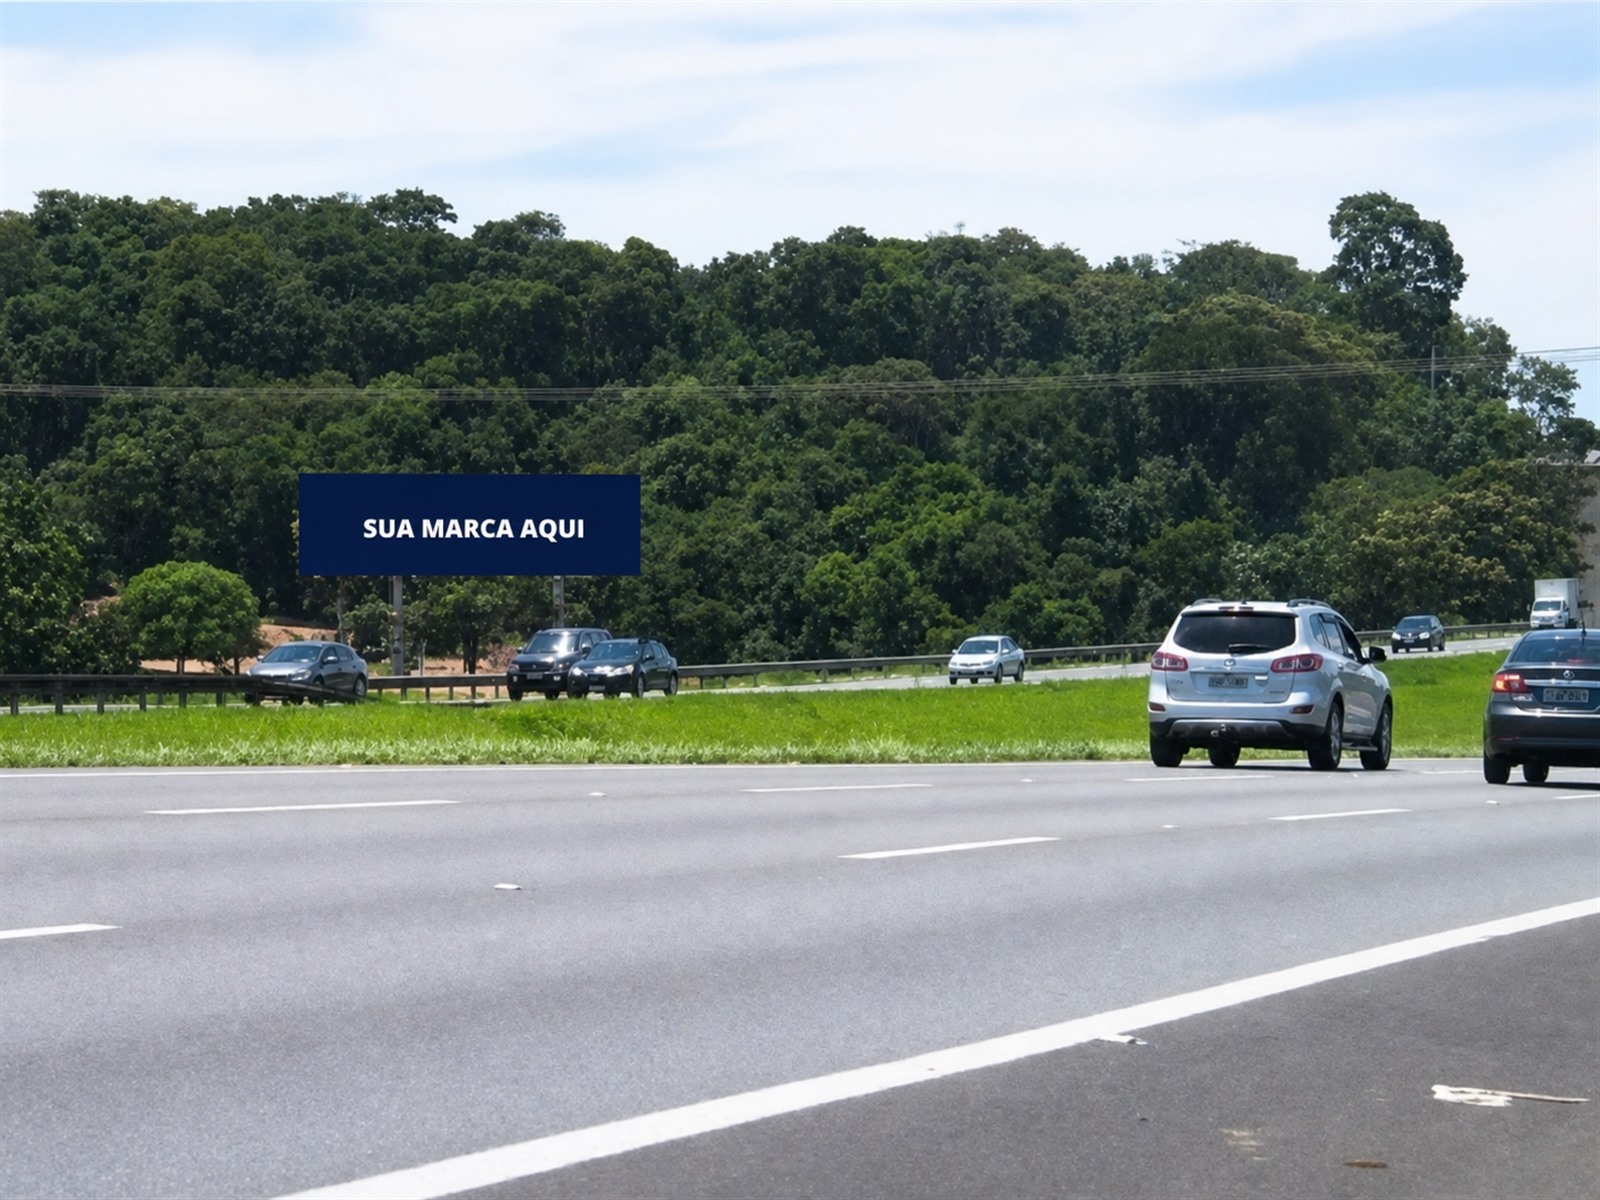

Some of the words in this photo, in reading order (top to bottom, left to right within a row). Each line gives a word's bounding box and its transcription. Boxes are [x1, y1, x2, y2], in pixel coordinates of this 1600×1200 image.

[364, 519, 414, 538] SUA
[423, 519, 514, 538] MARCA
[520, 519, 583, 542] AQUI
